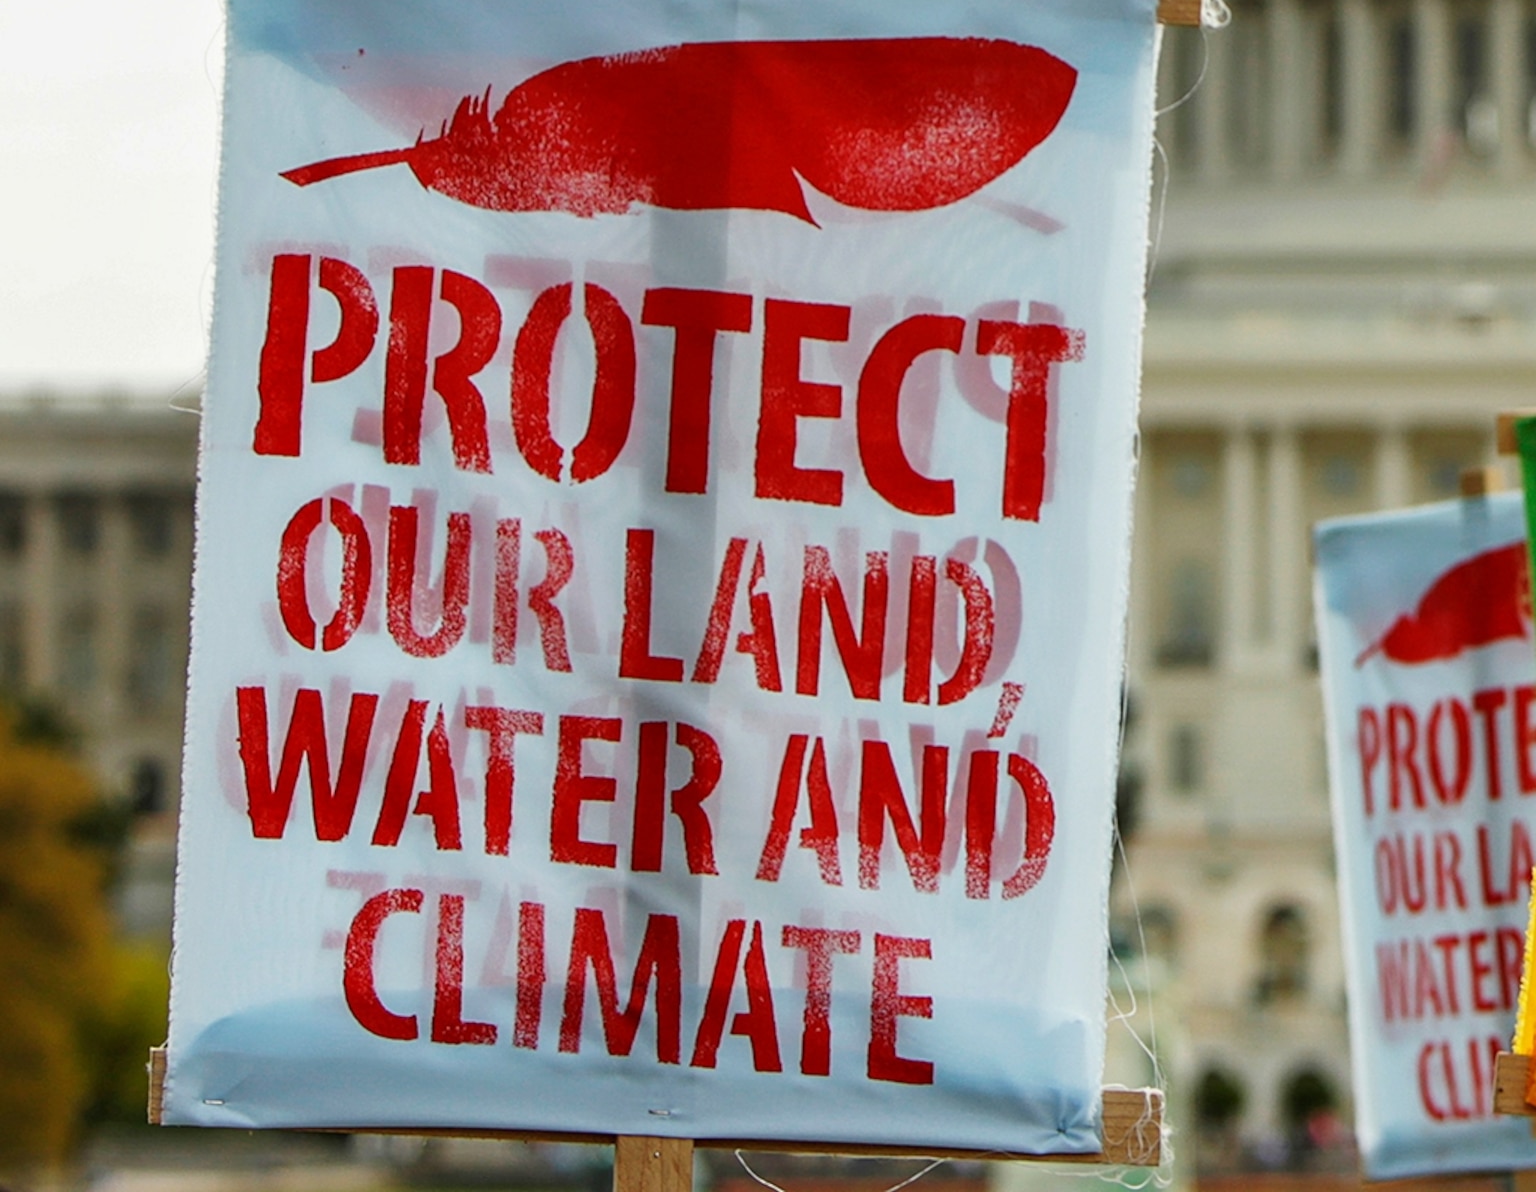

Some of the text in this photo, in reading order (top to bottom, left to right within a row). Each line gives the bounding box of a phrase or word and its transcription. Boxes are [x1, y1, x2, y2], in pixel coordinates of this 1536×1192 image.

[253, 253, 1086, 522] PROTECT
[277, 497, 1022, 738] OUR LAND,
[236, 686, 1055, 901] WATER AND
[1376, 819, 1534, 915] OUR LA
[343, 887, 933, 1085] CLIMATE
[1377, 927, 1526, 1023] WATER
[1417, 1037, 1502, 1121] CLI
